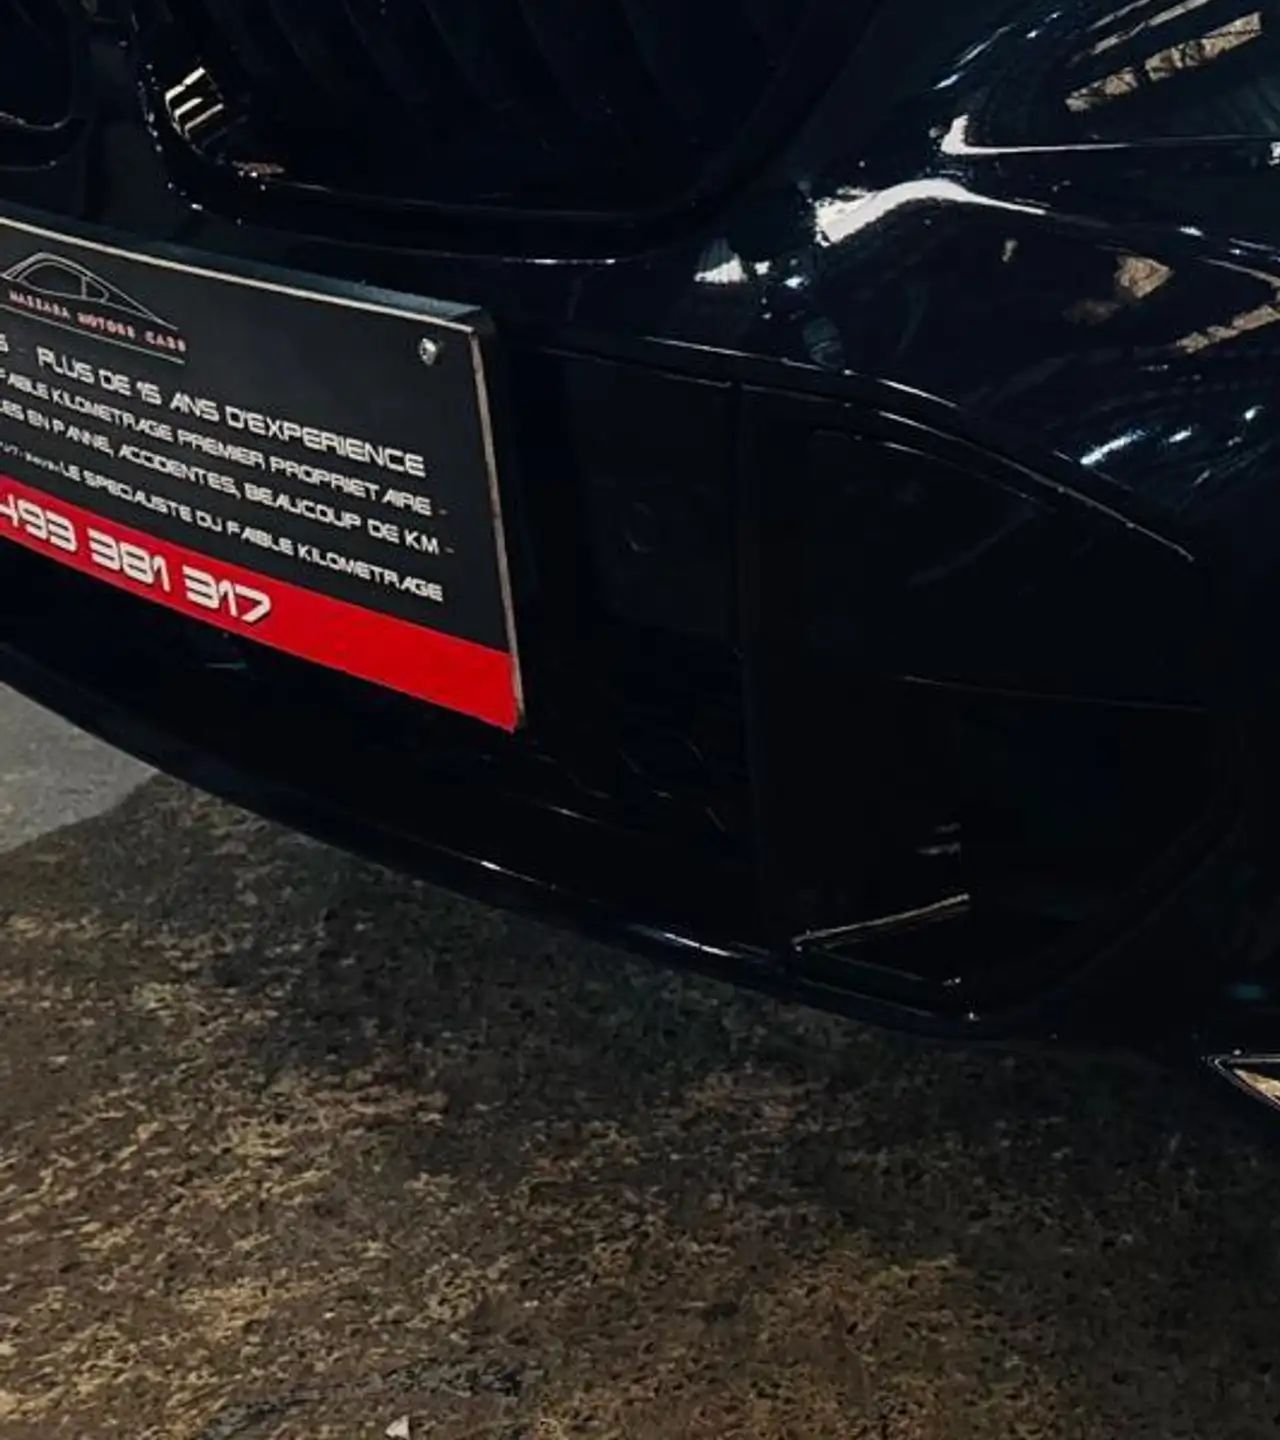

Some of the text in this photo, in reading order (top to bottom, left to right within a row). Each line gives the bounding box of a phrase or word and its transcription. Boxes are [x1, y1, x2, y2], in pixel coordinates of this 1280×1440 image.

[36, 345, 427, 478] PLUS DE 15 ANS D'EXPERIENCE
[52, 388, 174, 442] KILOMETRAGE
[177, 428, 265, 470] PREMIER
[27, 408, 50, 430] EN
[244, 481, 362, 530] BEAUCOUP
[366, 518, 400, 544] DE
[404, 529, 440, 555] KM
[60, 461, 82, 482] LE
[83, 469, 194, 522] SPECIALISTE
[195, 510, 223, 532] DU
[297, 542, 444, 602] KILOMETRAGE
[87, 527, 171, 592] 381
[183, 564, 272, 623] 317
